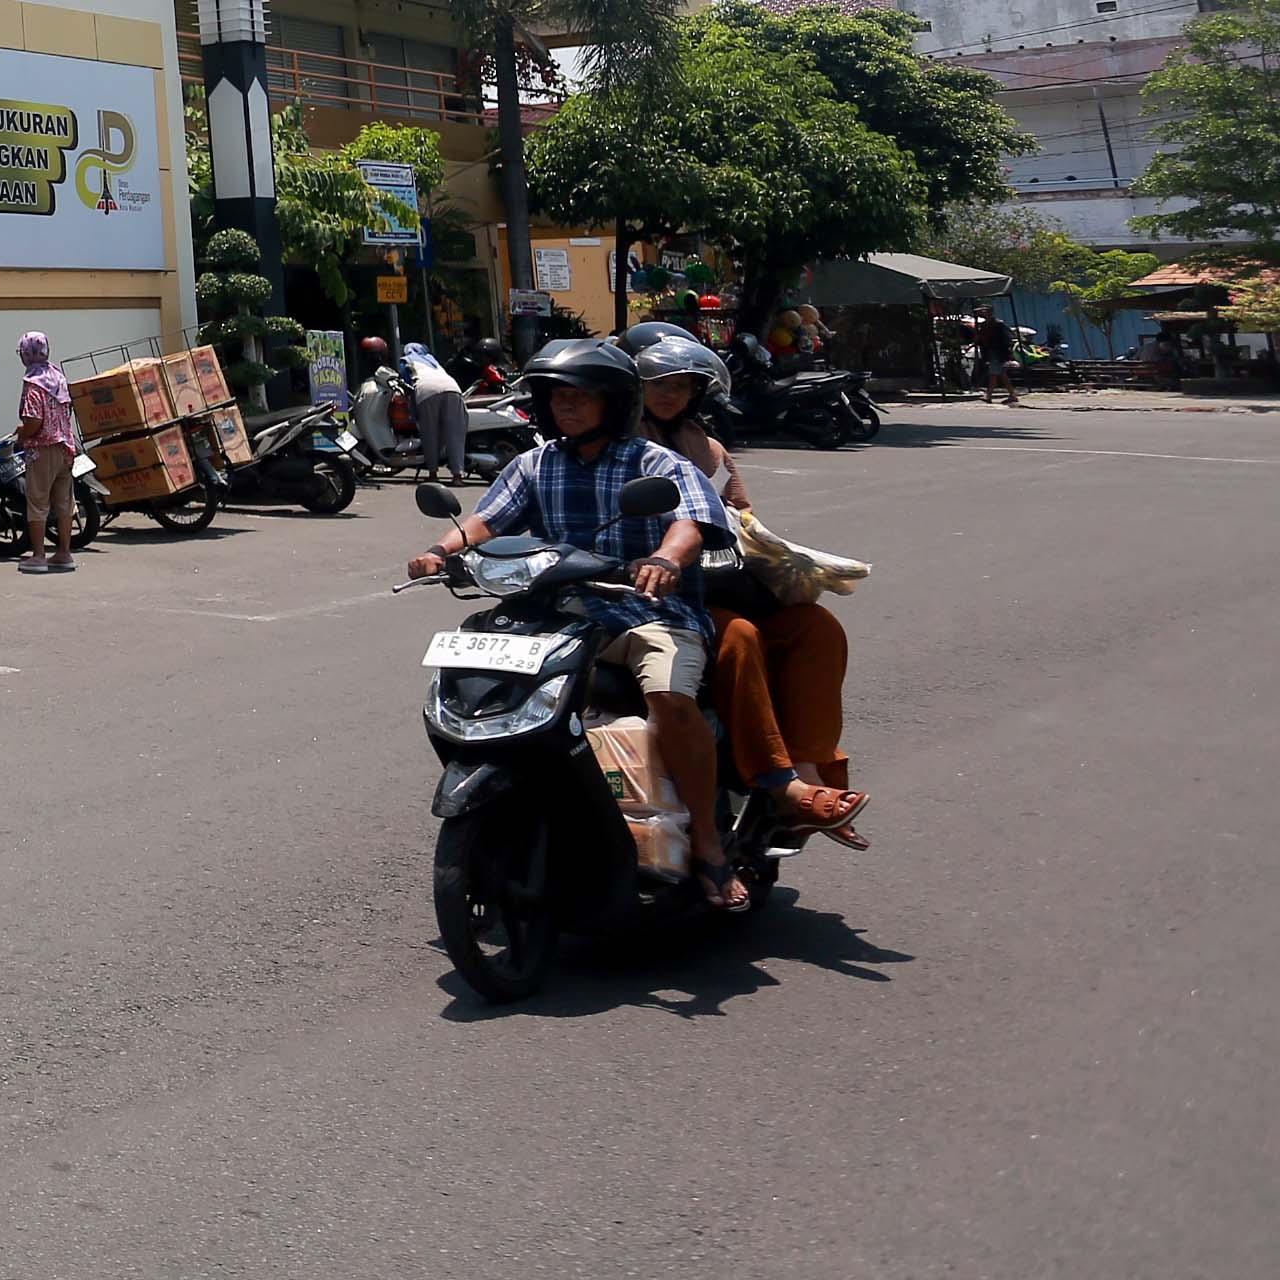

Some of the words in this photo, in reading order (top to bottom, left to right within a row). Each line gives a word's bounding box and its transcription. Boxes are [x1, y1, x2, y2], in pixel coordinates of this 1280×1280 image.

[436, 635, 460, 649] AE
[466, 637, 510, 652] 3677
[528, 642, 541, 656] B
